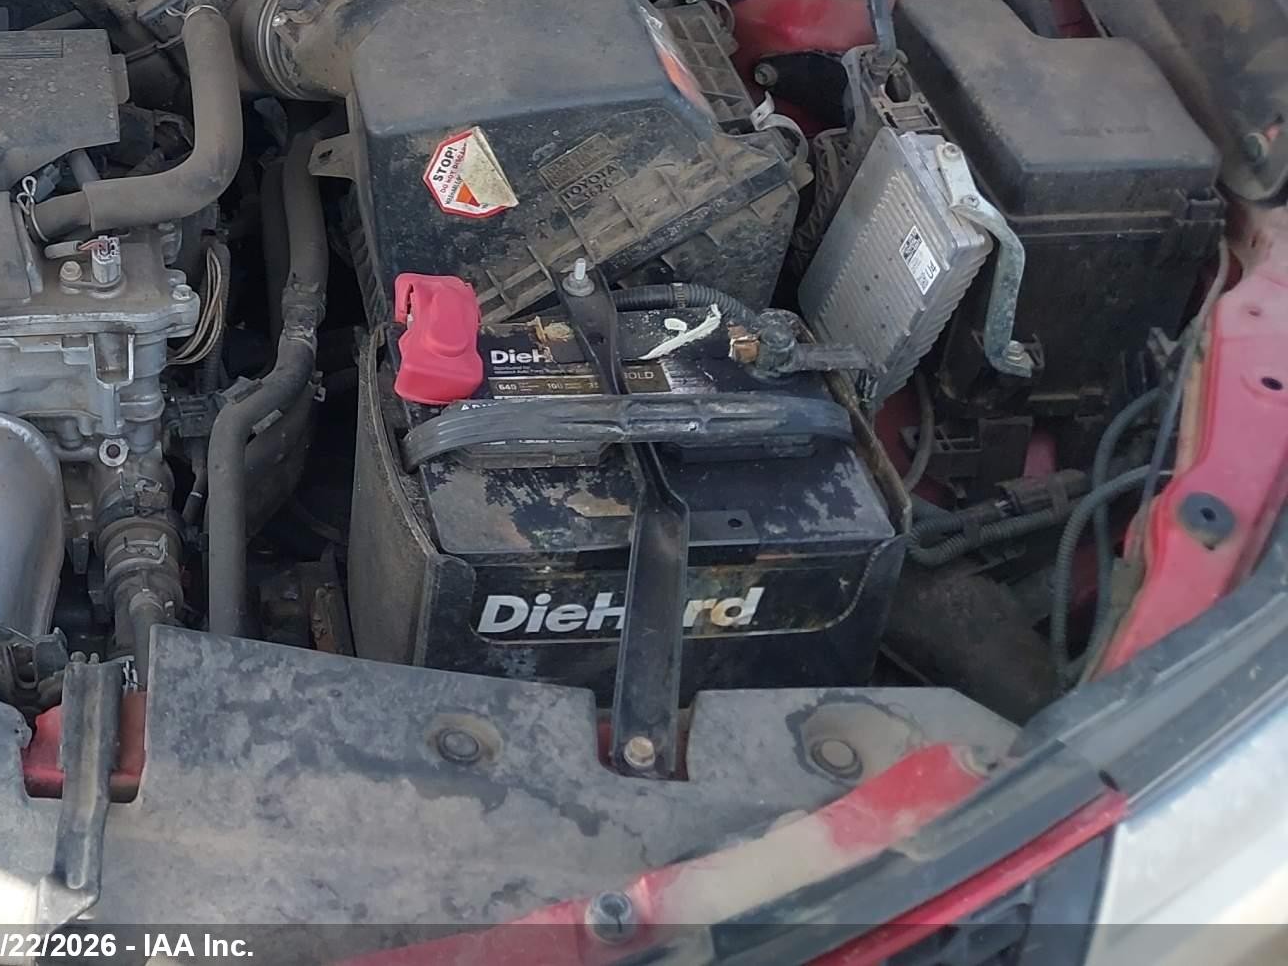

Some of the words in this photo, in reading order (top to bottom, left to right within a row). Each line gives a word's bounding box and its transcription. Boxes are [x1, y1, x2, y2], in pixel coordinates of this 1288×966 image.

[433, 147, 458, 182] STOP!
[440, 183, 449, 194] DO
[446, 170, 456, 184] NOT
[565, 164, 619, 199] TOYOTA
[477, 587, 765, 634] DieHrd
